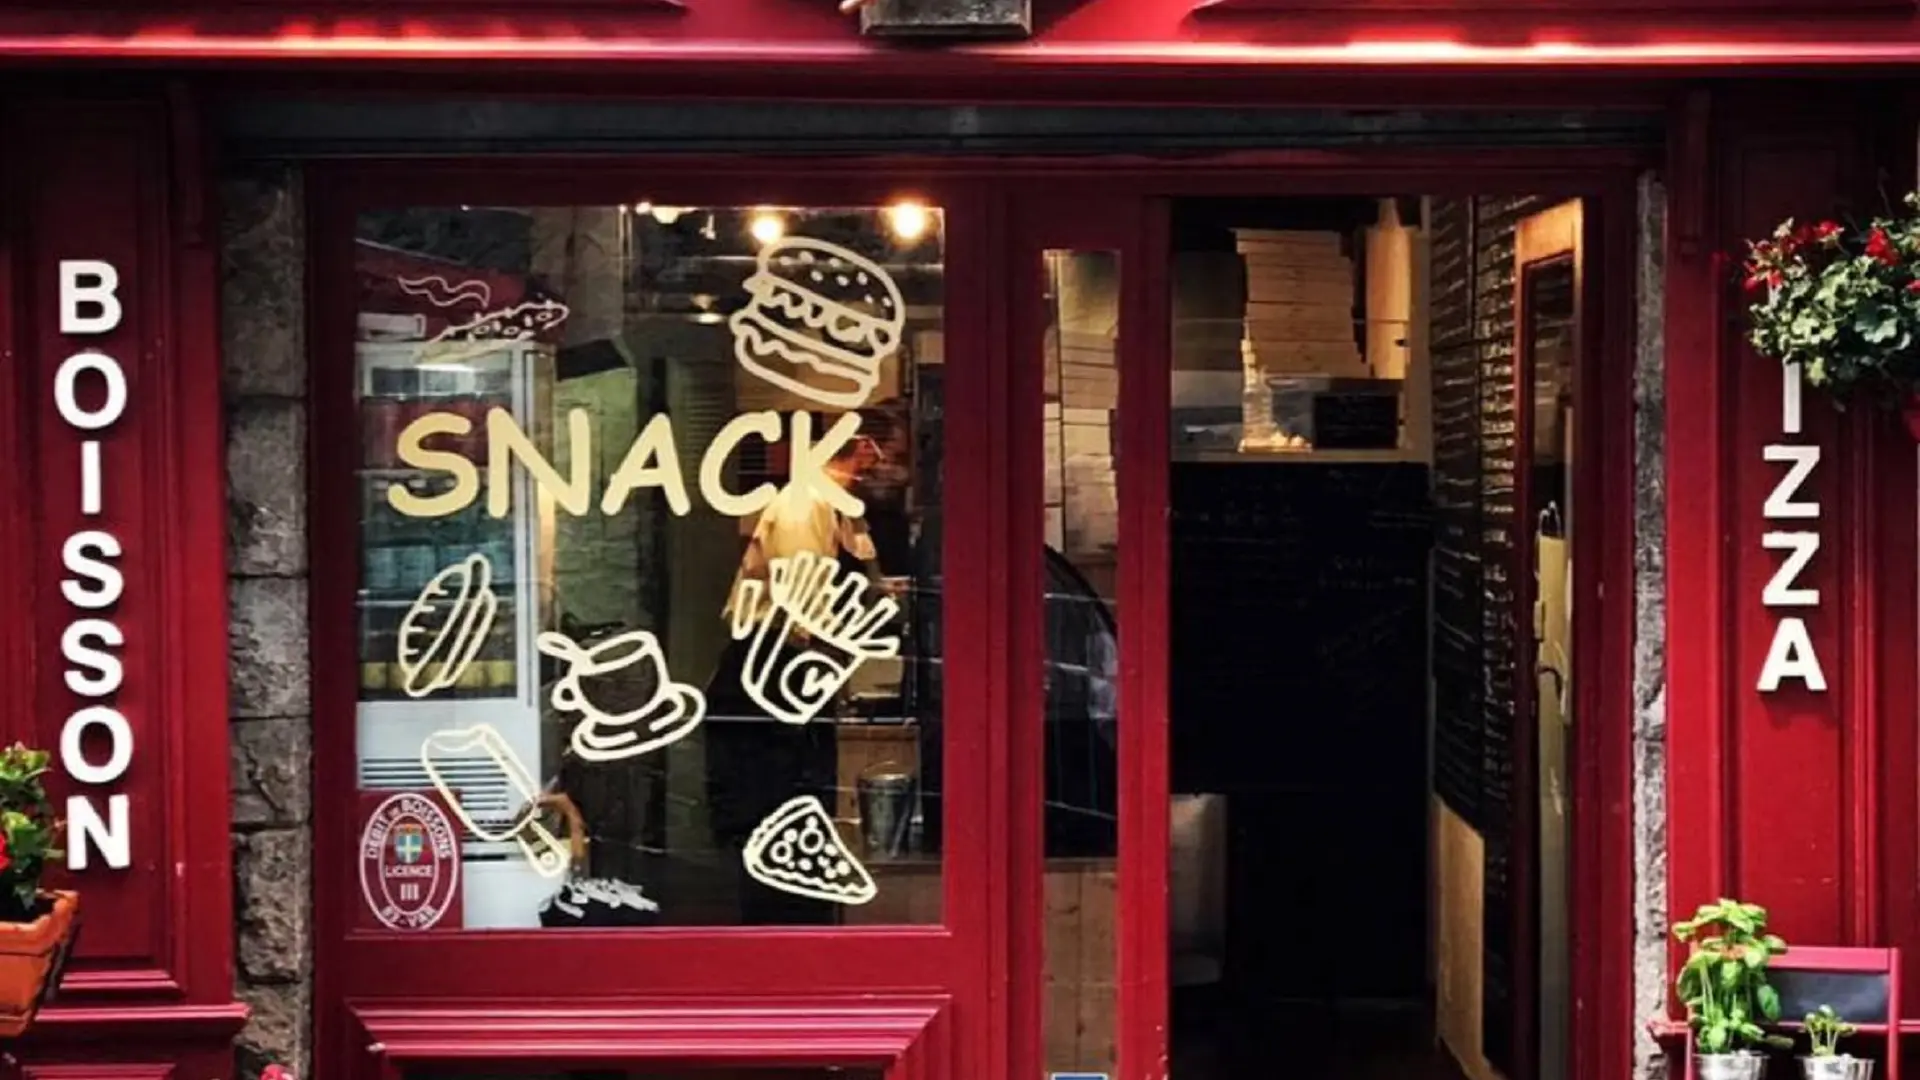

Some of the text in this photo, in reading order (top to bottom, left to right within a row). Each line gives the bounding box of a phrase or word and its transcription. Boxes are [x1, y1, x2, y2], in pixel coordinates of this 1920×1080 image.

[54, 260, 134, 870] BOISSON
[388, 407, 866, 518] SNACK
[1757, 288, 1827, 691] IZZA
[385, 865, 433, 878] LICENCE
